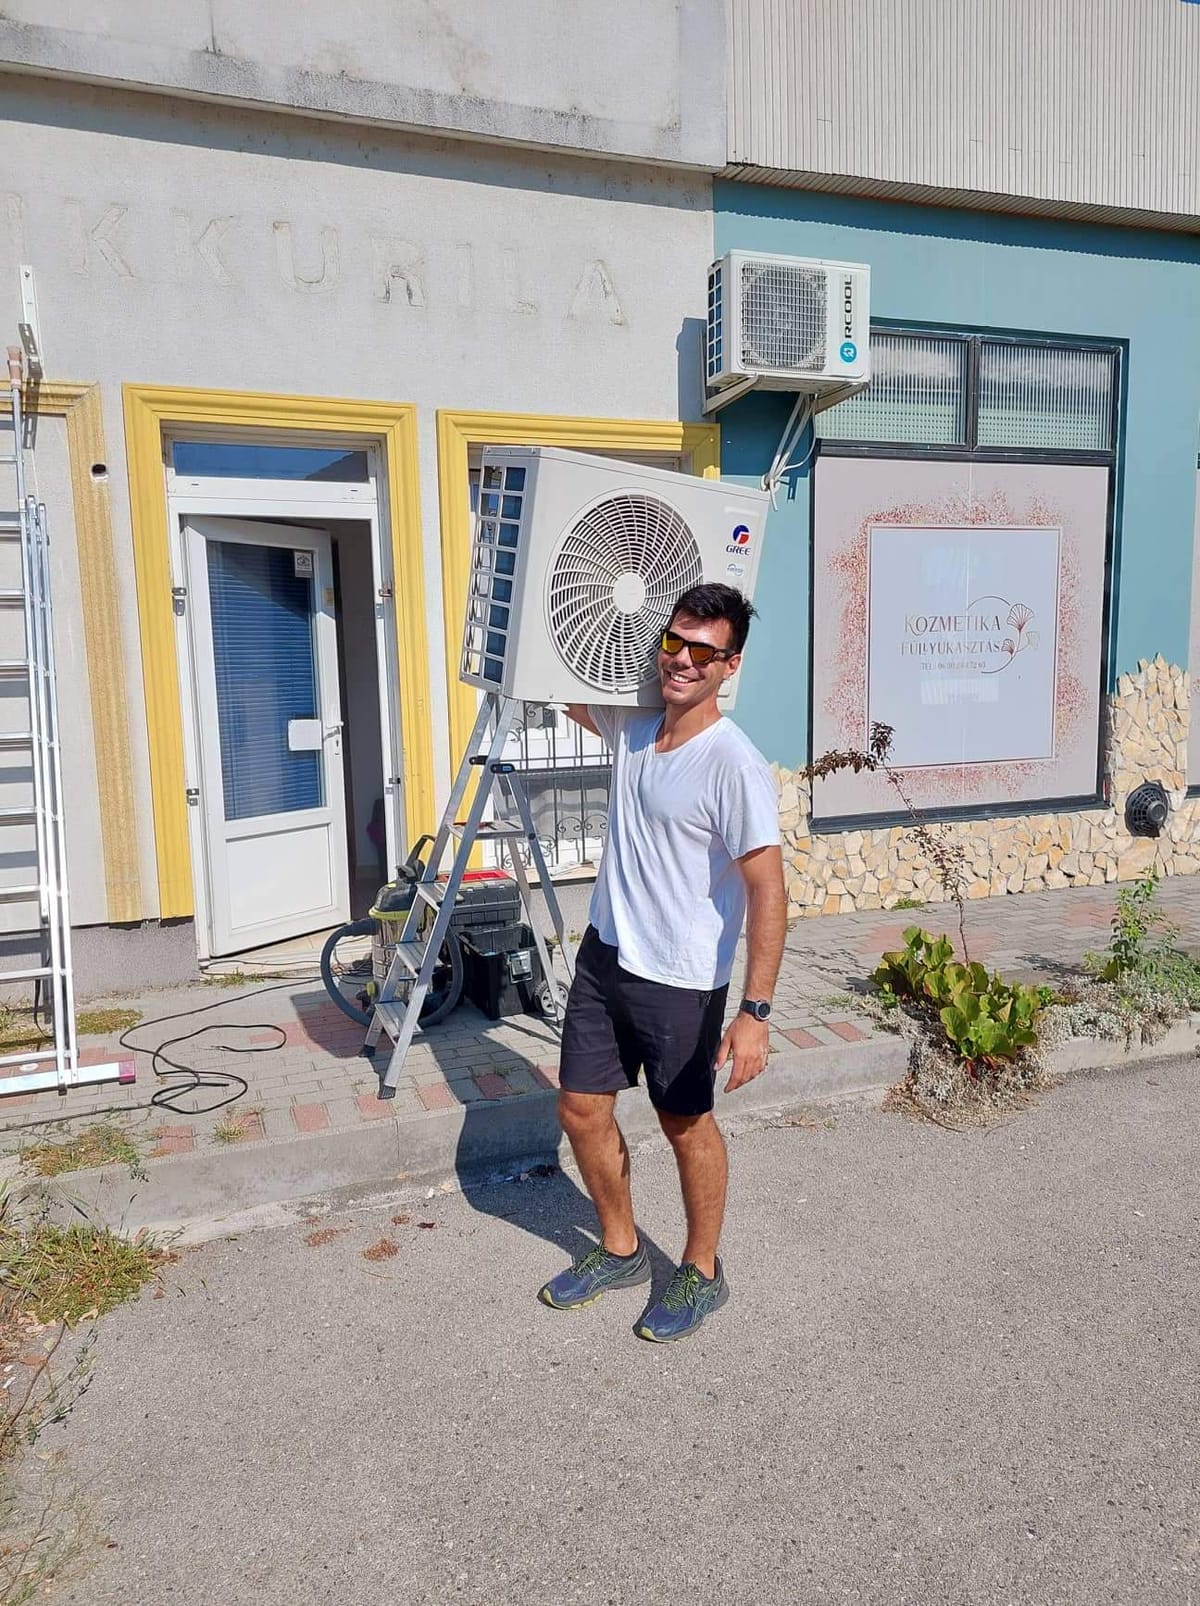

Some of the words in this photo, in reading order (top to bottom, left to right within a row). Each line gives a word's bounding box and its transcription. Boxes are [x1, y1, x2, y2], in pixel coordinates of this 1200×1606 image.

[844, 274, 853, 339] RCOOL
[725, 544, 751, 556] GREE
[904, 615, 1001, 636] KOZMETIKA
